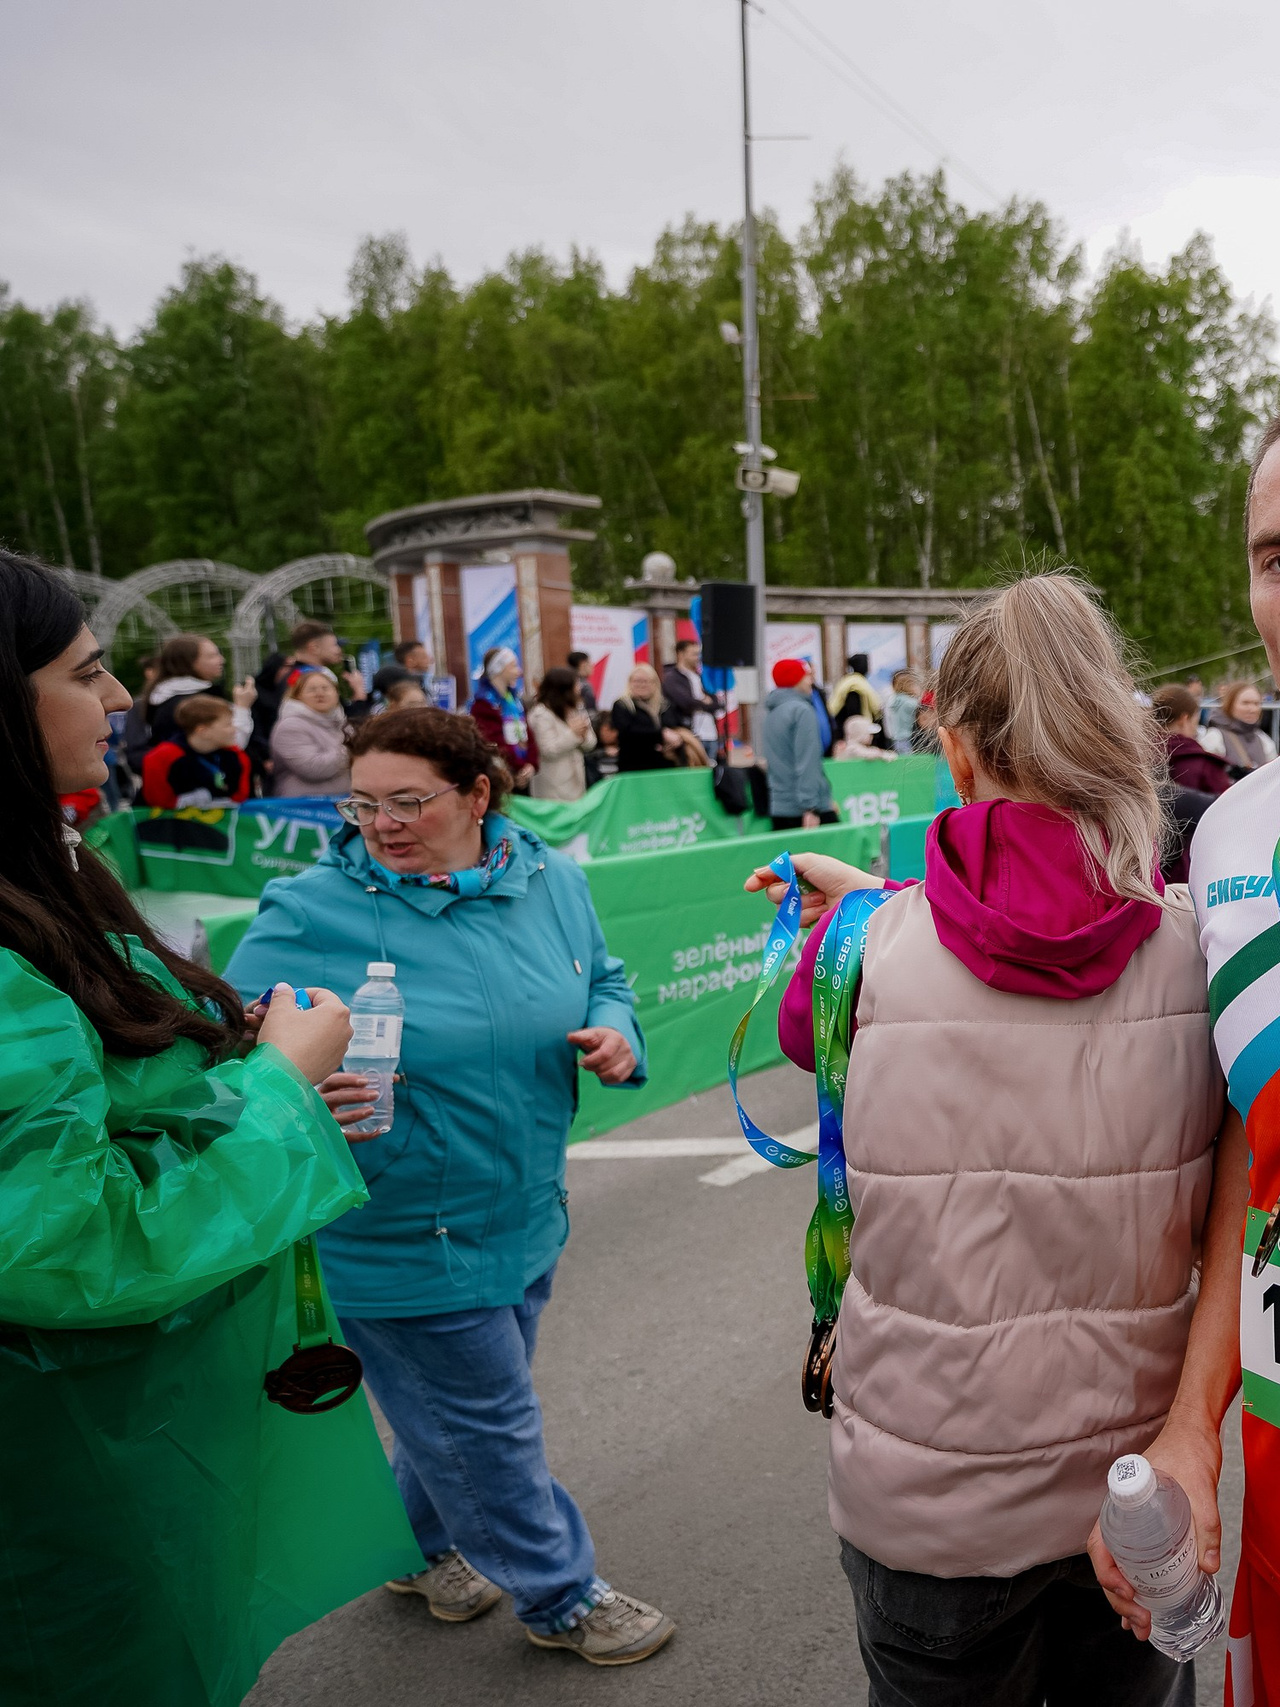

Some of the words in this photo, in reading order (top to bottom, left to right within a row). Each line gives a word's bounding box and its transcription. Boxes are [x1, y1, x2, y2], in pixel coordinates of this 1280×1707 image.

[843, 790, 901, 825] 185
[787, 897, 798, 916] Utair
[763, 952, 778, 976] СБЕР
[836, 936, 852, 971] СБЕР
[779, 1153, 808, 1164] СБЕР
[834, 1167, 844, 1197] СБЕР
